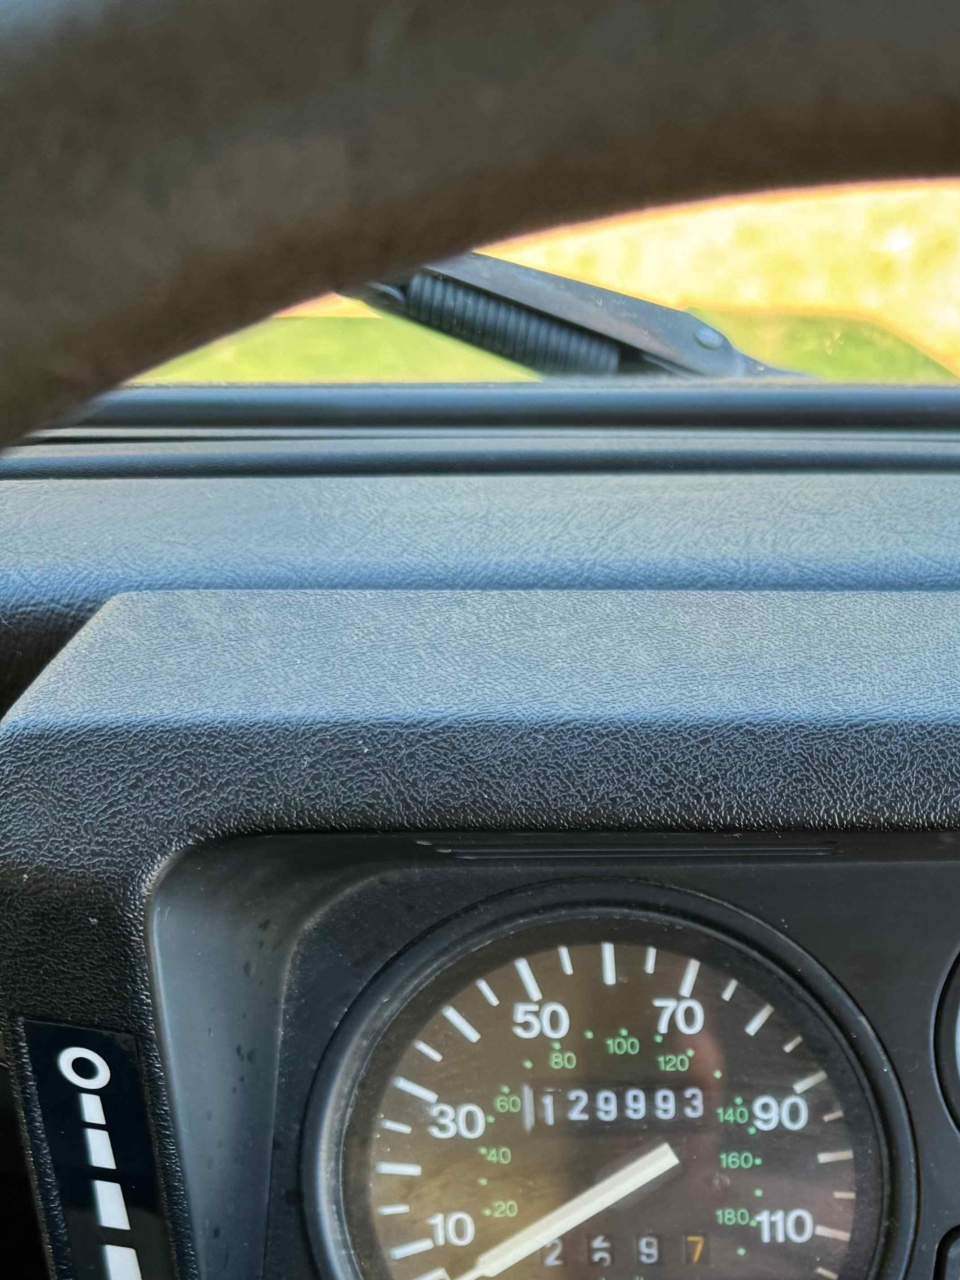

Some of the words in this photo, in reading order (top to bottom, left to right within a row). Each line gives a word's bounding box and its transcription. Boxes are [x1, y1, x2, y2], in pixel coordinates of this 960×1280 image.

[512, 1002, 570, 1039] 50
[652, 998, 704, 1034] 70
[606, 1037, 640, 1055] 100
[549, 1051, 577, 1069] 80
[657, 1054, 689, 1072] 120
[494, 1095, 521, 1113] 60
[752, 1095, 809, 1131] 90
[428, 1103, 486, 1139] 30
[716, 1107, 749, 1124] 140
[487, 1147, 511, 1164] 40
[719, 1152, 753, 1169] 160
[492, 1200, 518, 1218] 20
[716, 1208, 749, 1226] 180
[426, 1211, 475, 1246] 10
[755, 1209, 814, 1243] 110
